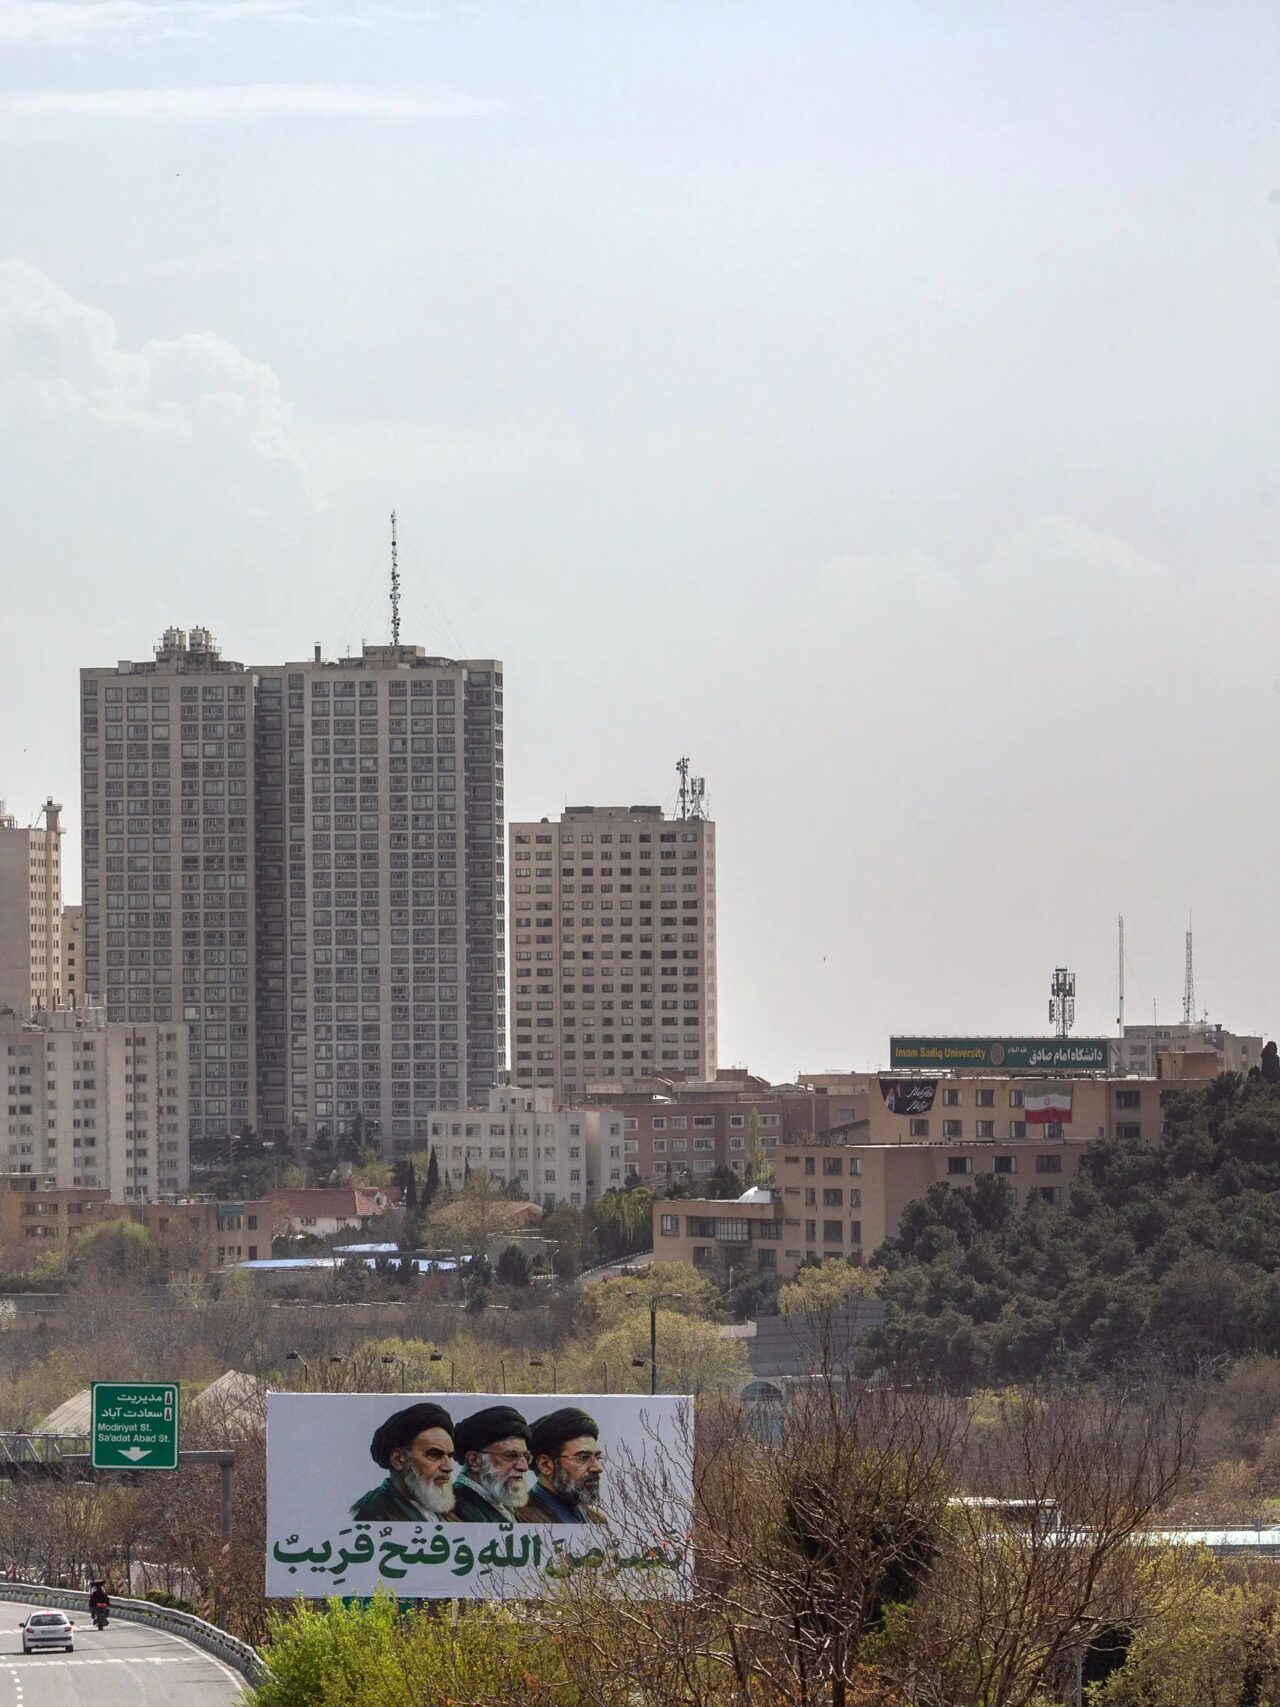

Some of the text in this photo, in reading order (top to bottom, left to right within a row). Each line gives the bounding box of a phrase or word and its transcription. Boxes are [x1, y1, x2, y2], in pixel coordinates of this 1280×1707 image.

[895, 1047, 986, 1060] Imam Sadiq University
[1029, 1047, 1103, 1066] دانشگاه امام صادق
[116, 1393, 163, 1404] مدیریت
[101, 1407, 163, 1420] سعادت آباد
[97, 1423, 152, 1433] Modiriyat St.
[98, 1434, 171, 1443] Sa'adat Abad St.
